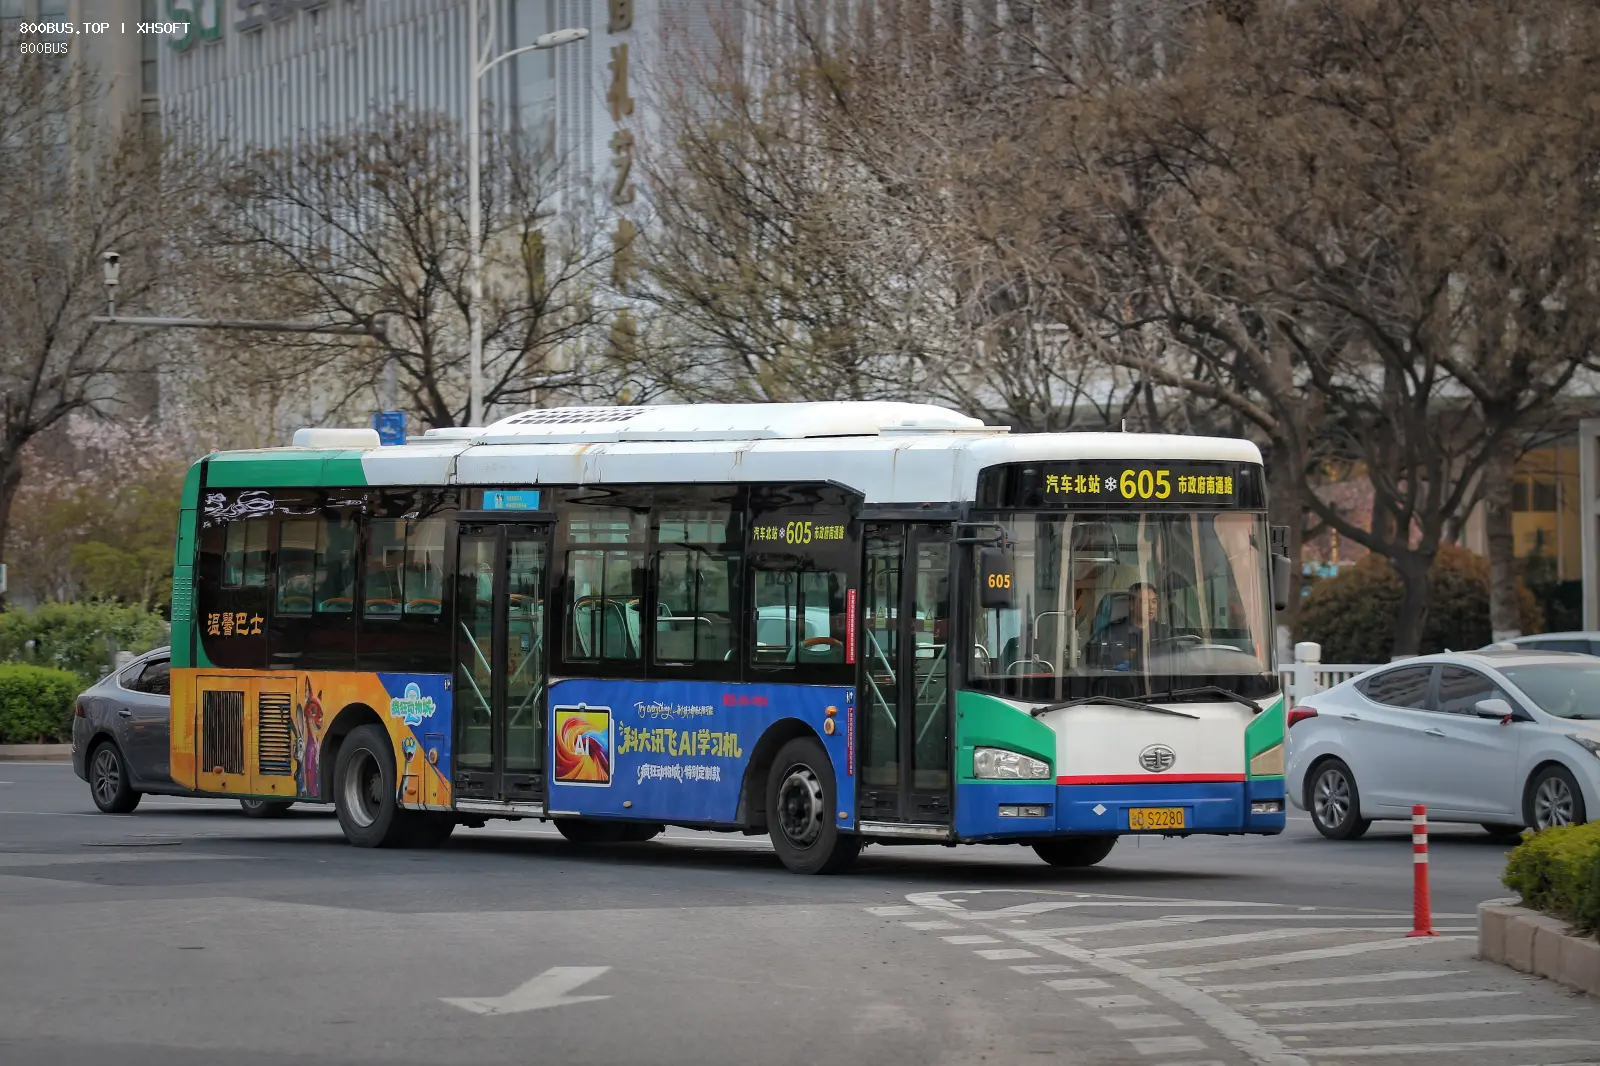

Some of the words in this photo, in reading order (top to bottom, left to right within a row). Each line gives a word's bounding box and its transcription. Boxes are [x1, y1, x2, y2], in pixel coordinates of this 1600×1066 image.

[1046, 474, 1101, 494] 汽车北站
[1119, 469, 1171, 499] 605
[1177, 475, 1233, 495] 市政府南通路
[753, 526, 778, 540] 汽车北站
[786, 521, 812, 544] 605
[987, 573, 1011, 589] 605
[617, 726, 743, 759] 科大讯飞AI学习机
[1148, 811, 1182, 826] S2280
